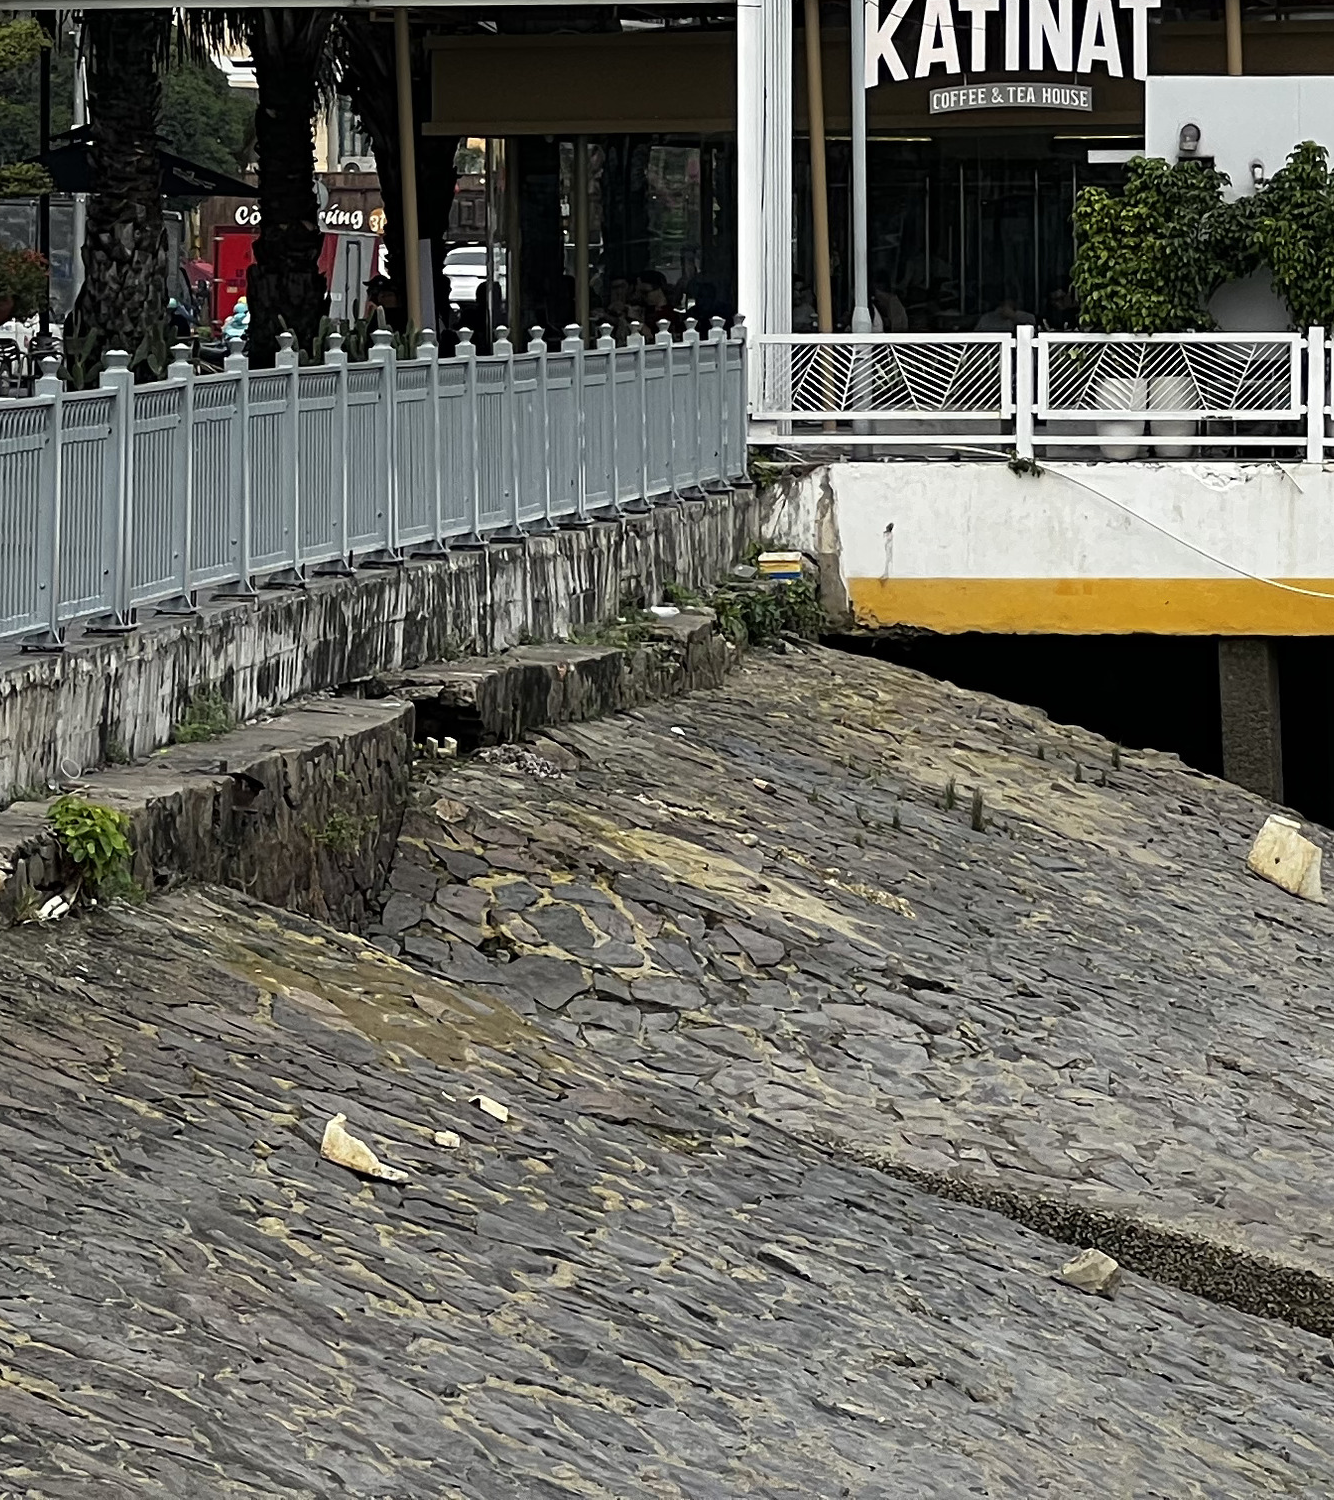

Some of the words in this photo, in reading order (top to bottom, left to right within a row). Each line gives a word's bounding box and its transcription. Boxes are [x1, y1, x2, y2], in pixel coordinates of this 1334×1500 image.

[932, 88, 987, 110] COFFEE
[991, 87, 1004, 104] &
[1007, 86, 1036, 104] TEA
[1042, 87, 1089, 107] HOUSE
